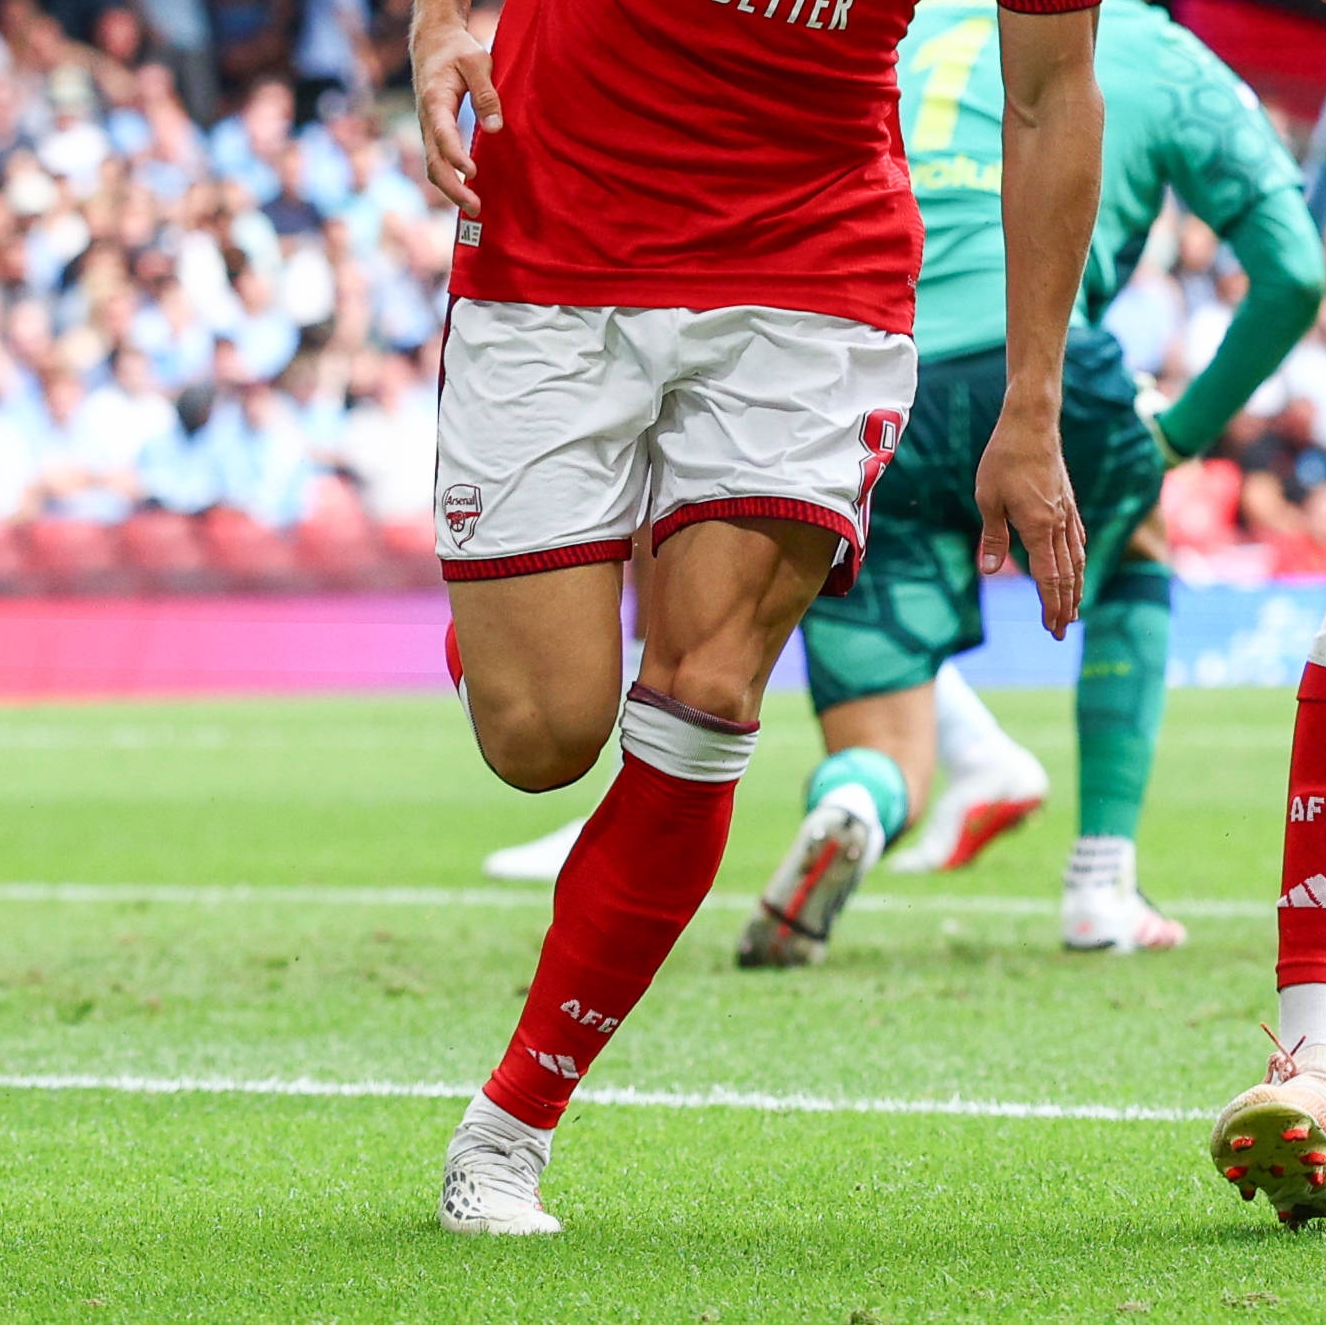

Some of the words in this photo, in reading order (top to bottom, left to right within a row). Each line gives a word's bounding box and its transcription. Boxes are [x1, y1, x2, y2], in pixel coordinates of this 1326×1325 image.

[910, 16, 994, 151] 1
[445, 495, 475, 505] Arsenal
[560, 999, 619, 1034] AFC
